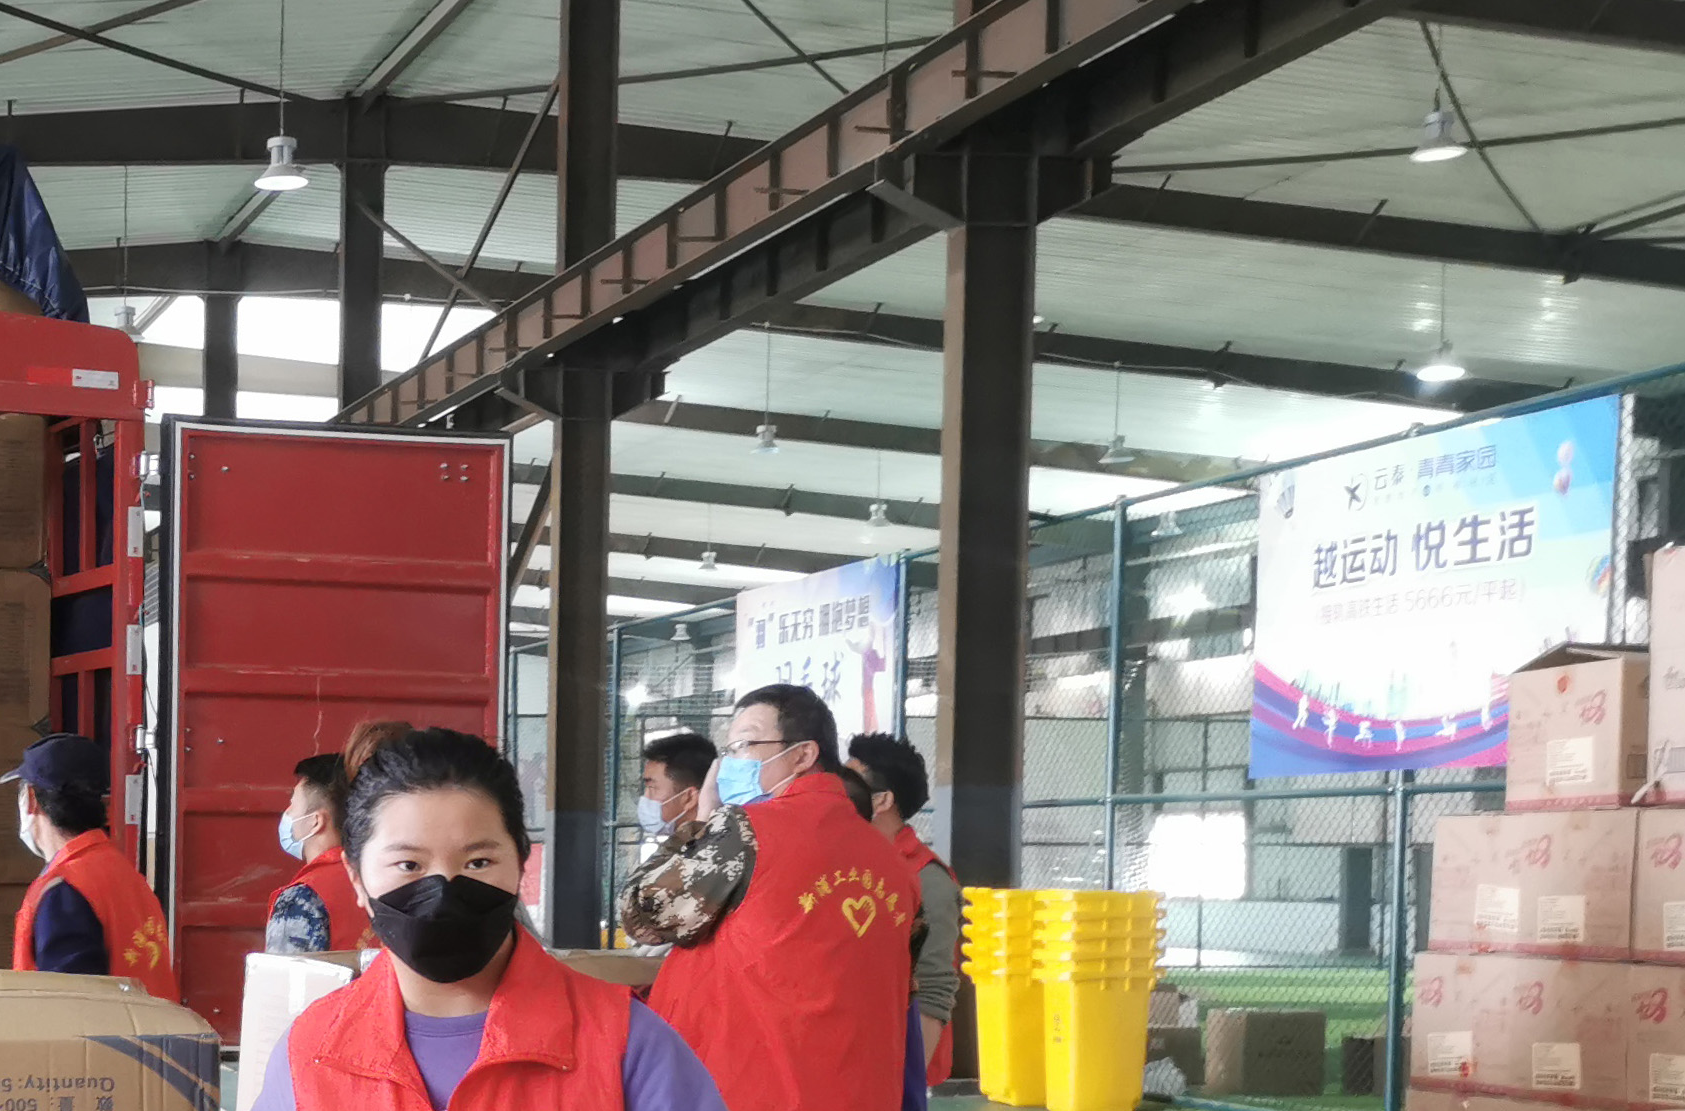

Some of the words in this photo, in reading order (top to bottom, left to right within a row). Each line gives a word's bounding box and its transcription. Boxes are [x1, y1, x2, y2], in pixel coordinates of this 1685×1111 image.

[1374, 464, 1405, 491] 云泰
[1418, 444, 1497, 481] 青青家园
[1312, 528, 1398, 589] 越运动
[1412, 506, 1535, 571] 悦生活
[17, 1075, 116, 1093] Quantity:
